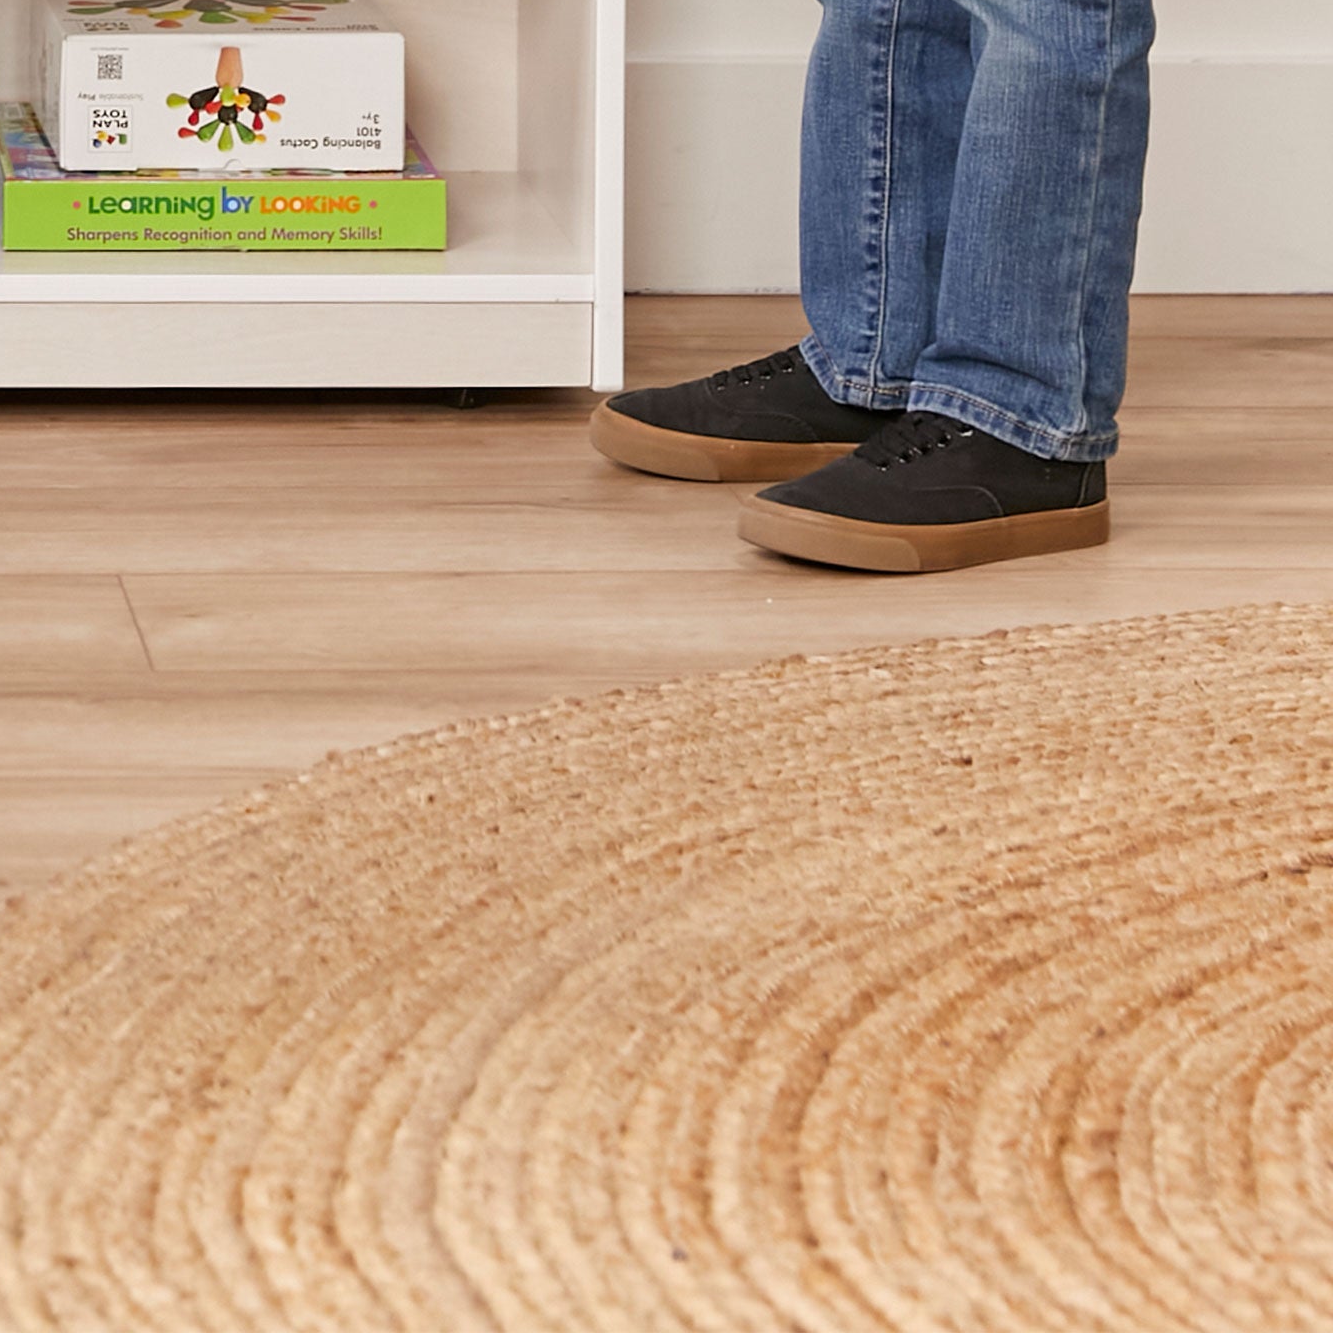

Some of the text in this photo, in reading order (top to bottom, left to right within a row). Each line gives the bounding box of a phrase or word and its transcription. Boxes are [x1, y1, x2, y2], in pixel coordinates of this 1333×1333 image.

[77, 92, 96, 101] Play
[93, 109, 128, 118] TOYS
[92, 120, 128, 129] PLAN
[357, 127, 382, 137] 4101
[280, 136, 381, 150] Balancing Cactus
[67, 227, 383, 243] Sharpens Recognition and Memory Skills!
